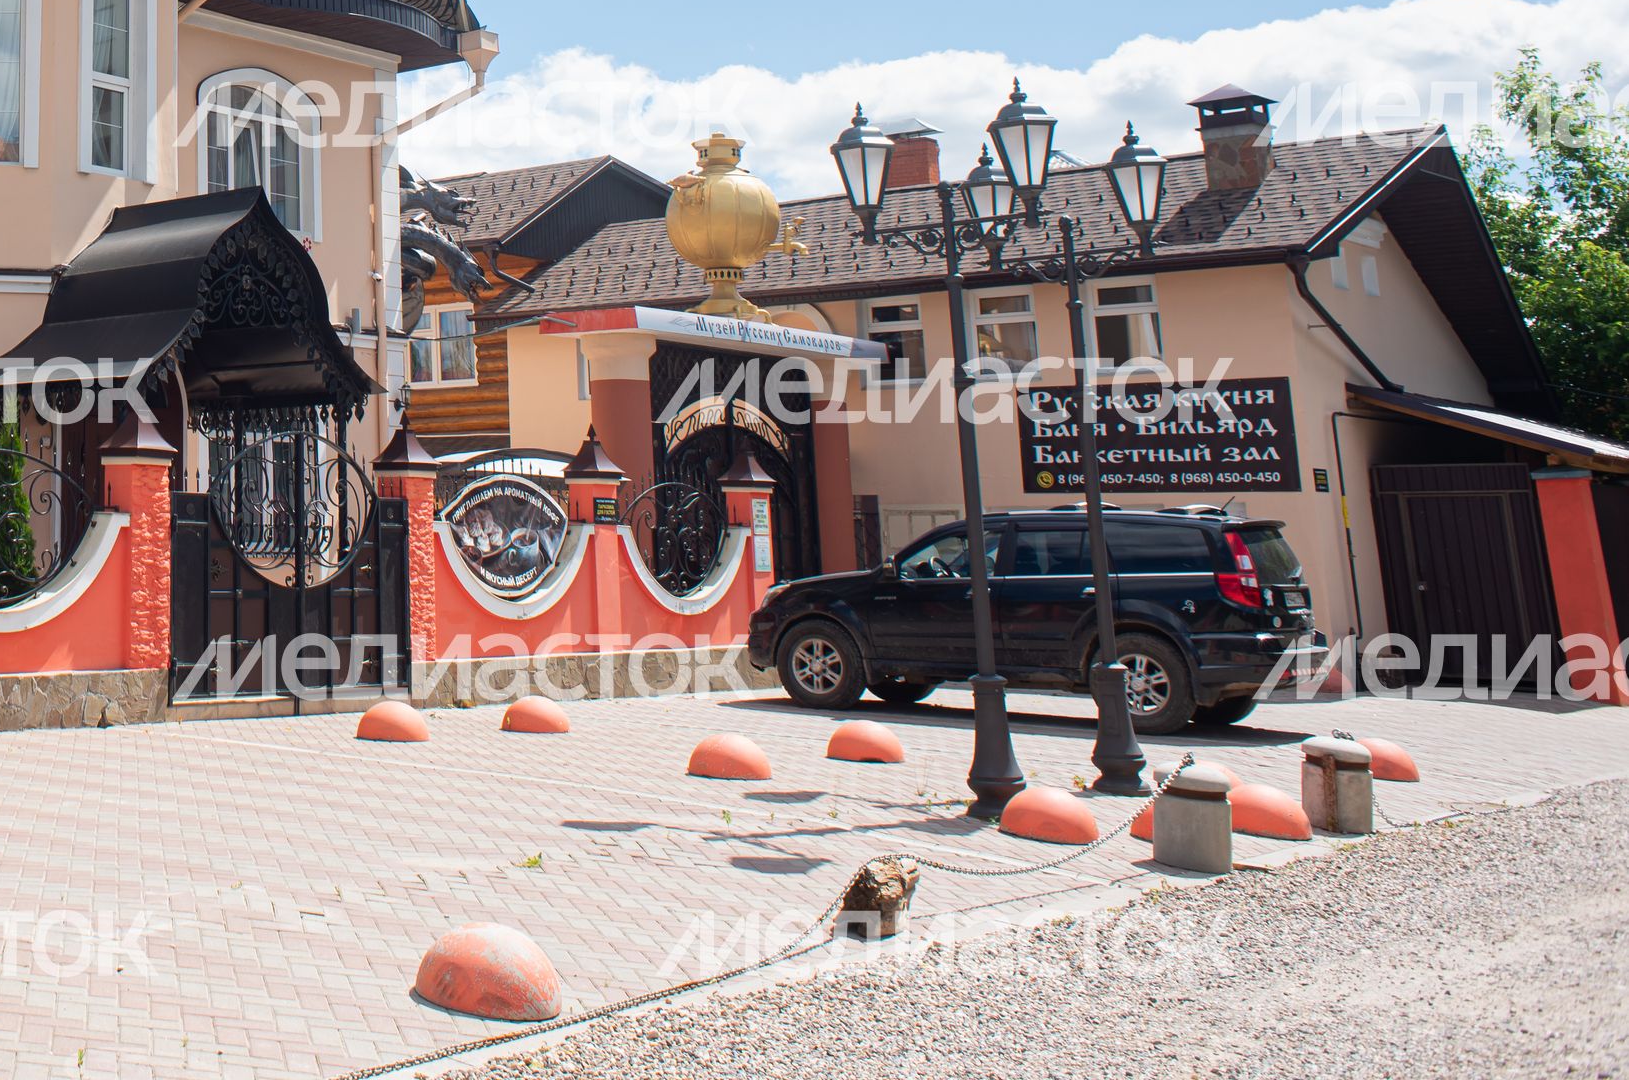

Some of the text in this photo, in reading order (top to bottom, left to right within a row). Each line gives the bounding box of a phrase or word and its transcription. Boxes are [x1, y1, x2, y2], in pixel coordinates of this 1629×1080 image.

[696, 316, 841, 352] Музей Русских Самоваров
[1031, 389, 1275, 417] Руская кухня
[1135, 416, 1278, 439] Бильярд
[1221, 446, 1280, 462] зал
[1058, 474, 1066, 484] 8
[1101, 474, 1164, 486] 450-7-450;
[1171, 473, 1178, 484] 8
[1181, 472, 1213, 486] (968)
[1217, 472, 1280, 484] 450-0-450
[452, 488, 493, 524] ПРИГЛАШАЕМ
[494, 487, 503, 497] НА
[504, 486, 542, 510] АРОМАТНЫЙ
[480, 566, 538, 587] И ВКУСНЫЙ ДЕСЕРТ
